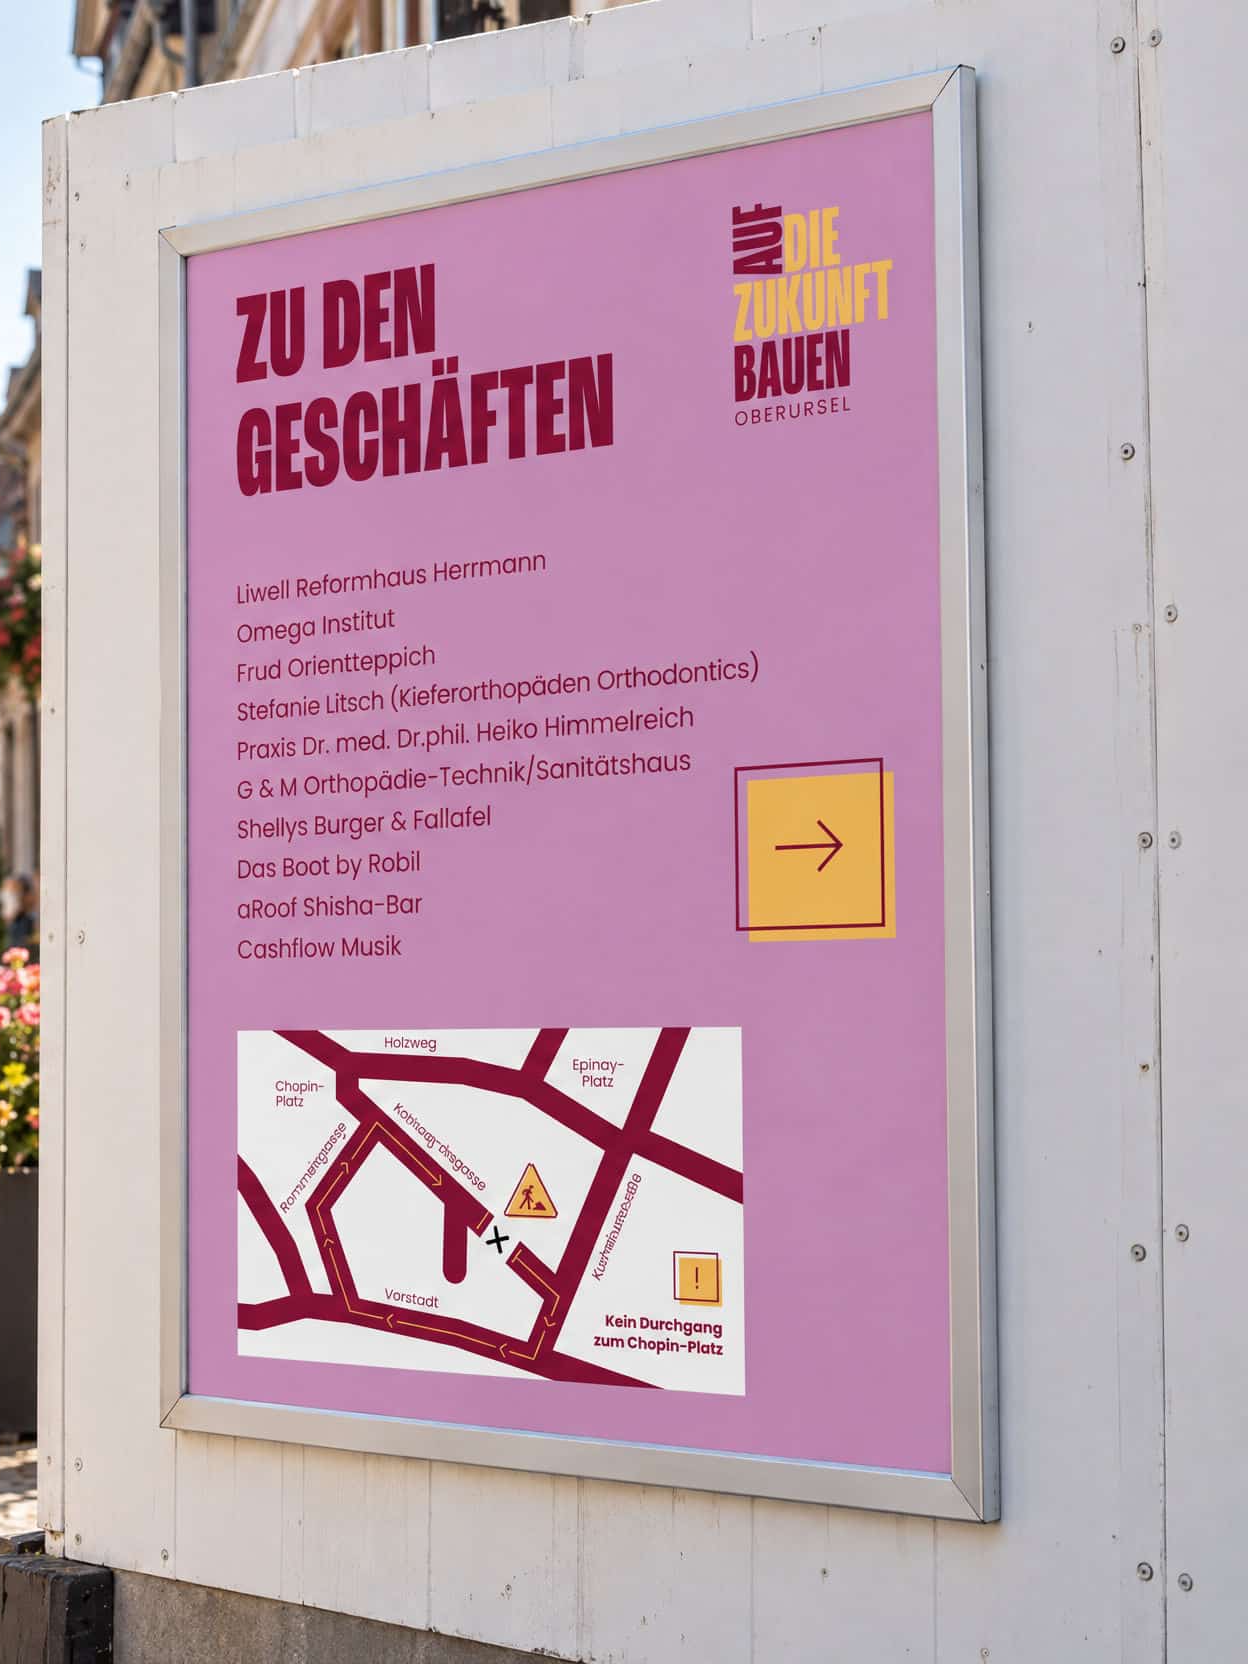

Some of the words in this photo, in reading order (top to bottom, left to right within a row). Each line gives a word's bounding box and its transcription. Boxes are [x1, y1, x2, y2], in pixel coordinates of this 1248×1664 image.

[732, 203, 783, 275] AUF
[783, 206, 841, 273] DIE
[733, 259, 893, 342] ZUKUNFT
[236, 286, 305, 384] ZU
[323, 263, 436, 370] DEN
[734, 328, 851, 402] BAUEN
[236, 353, 614, 497] GESCHÄFTEN
[735, 396, 851, 426] OBERURSEL
[236, 579, 289, 604] Liwell
[297, 568, 426, 598] Reformhaus
[434, 554, 546, 583] Herrmann
[236, 620, 315, 644] Omega
[323, 608, 395, 635] Institut
[237, 659, 281, 683] Frud
[288, 645, 435, 677] Orientteppich
[237, 697, 320, 721] Stefanie
[326, 690, 384, 714] Litsch
[390, 673, 590, 712] (Kieferorthopäden
[597, 650, 759, 691] Orthodontics)
[237, 737, 296, 761] Praxis
[303, 736, 329, 756] Dr.
[336, 729, 390, 754] med.
[397, 723, 469, 752] Dr.phil.
[477, 718, 537, 743] Heiko
[545, 706, 693, 737] Himmelreich
[237, 780, 253, 800] G
[259, 779, 274, 799] &
[280, 778, 296, 797] M
[304, 752, 691, 798] Orthopädie-Technik/Sanitätshaus
[237, 817, 308, 843] Shellys
[314, 814, 384, 839] Burger
[391, 810, 407, 831] &
[413, 805, 491, 831] Fallafel
[237, 859, 276, 880] Das
[283, 856, 330, 877] Boot
[336, 854, 362, 880] by
[368, 850, 421, 873] Robil
[237, 897, 297, 920] aRoof
[304, 894, 422, 918] Shisha-Bar
[237, 937, 335, 960] Cashflow
[341, 934, 402, 957] Musik
[384, 1036, 437, 1052] Holzweg
[572, 1058, 625, 1074] Epinay-
[582, 1075, 614, 1088] Platz
[275, 1080, 325, 1095] Chopin-
[276, 1095, 304, 1107] Platz
[384, 1288, 439, 1309] Vorstadt
[605, 1315, 637, 1329] Kein
[639, 1317, 723, 1339] Durchgang
[593, 1336, 624, 1348] zum
[627, 1336, 724, 1356] Chopin-Platz
